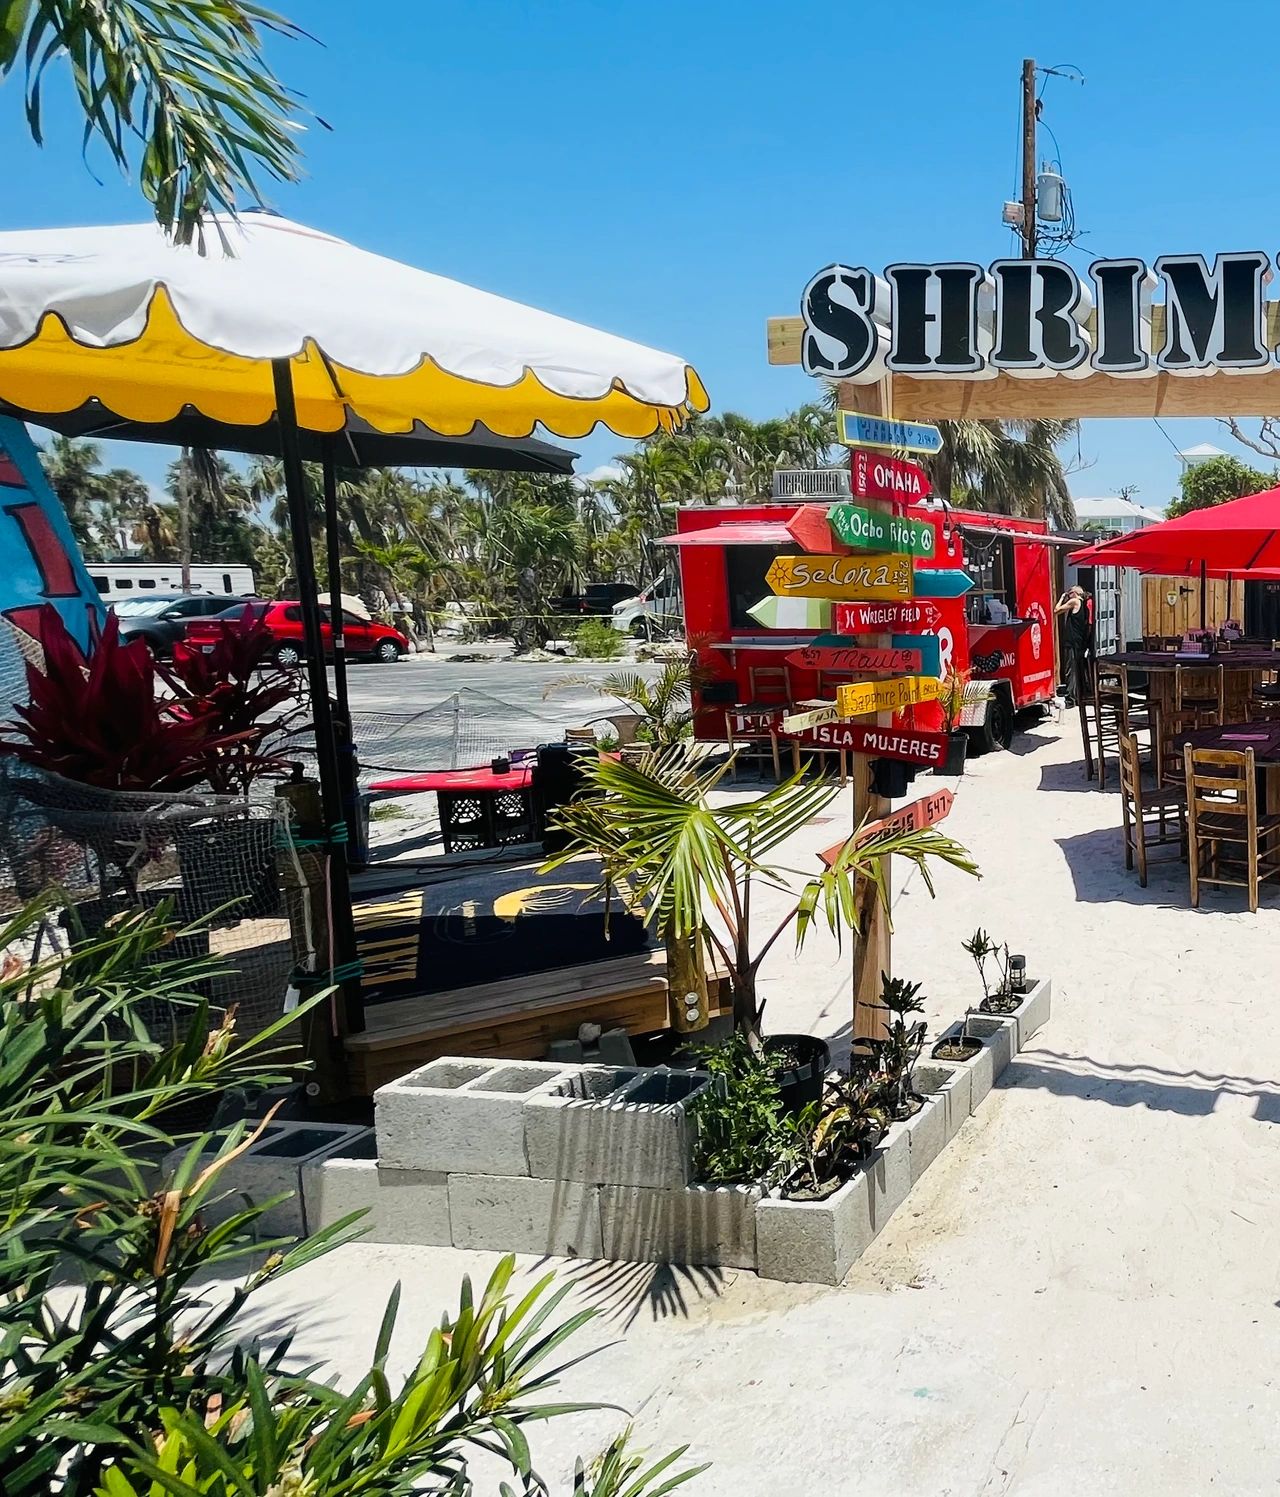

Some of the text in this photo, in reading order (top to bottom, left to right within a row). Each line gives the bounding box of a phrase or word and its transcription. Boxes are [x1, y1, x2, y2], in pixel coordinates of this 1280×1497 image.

[874, 464, 921, 493] OMAHA
[850, 513, 916, 546] Ocho Rios
[784, 559, 891, 588] Sedona
[859, 607, 898, 624] WRIGLEY
[901, 606, 921, 623] FIELD
[831, 649, 898, 669] Maui
[851, 685, 896, 712] Sapphire
[898, 682, 920, 703] Point
[813, 726, 853, 746] ISLA
[863, 732, 941, 760] MUJERES
[927, 796, 946, 821] 547
